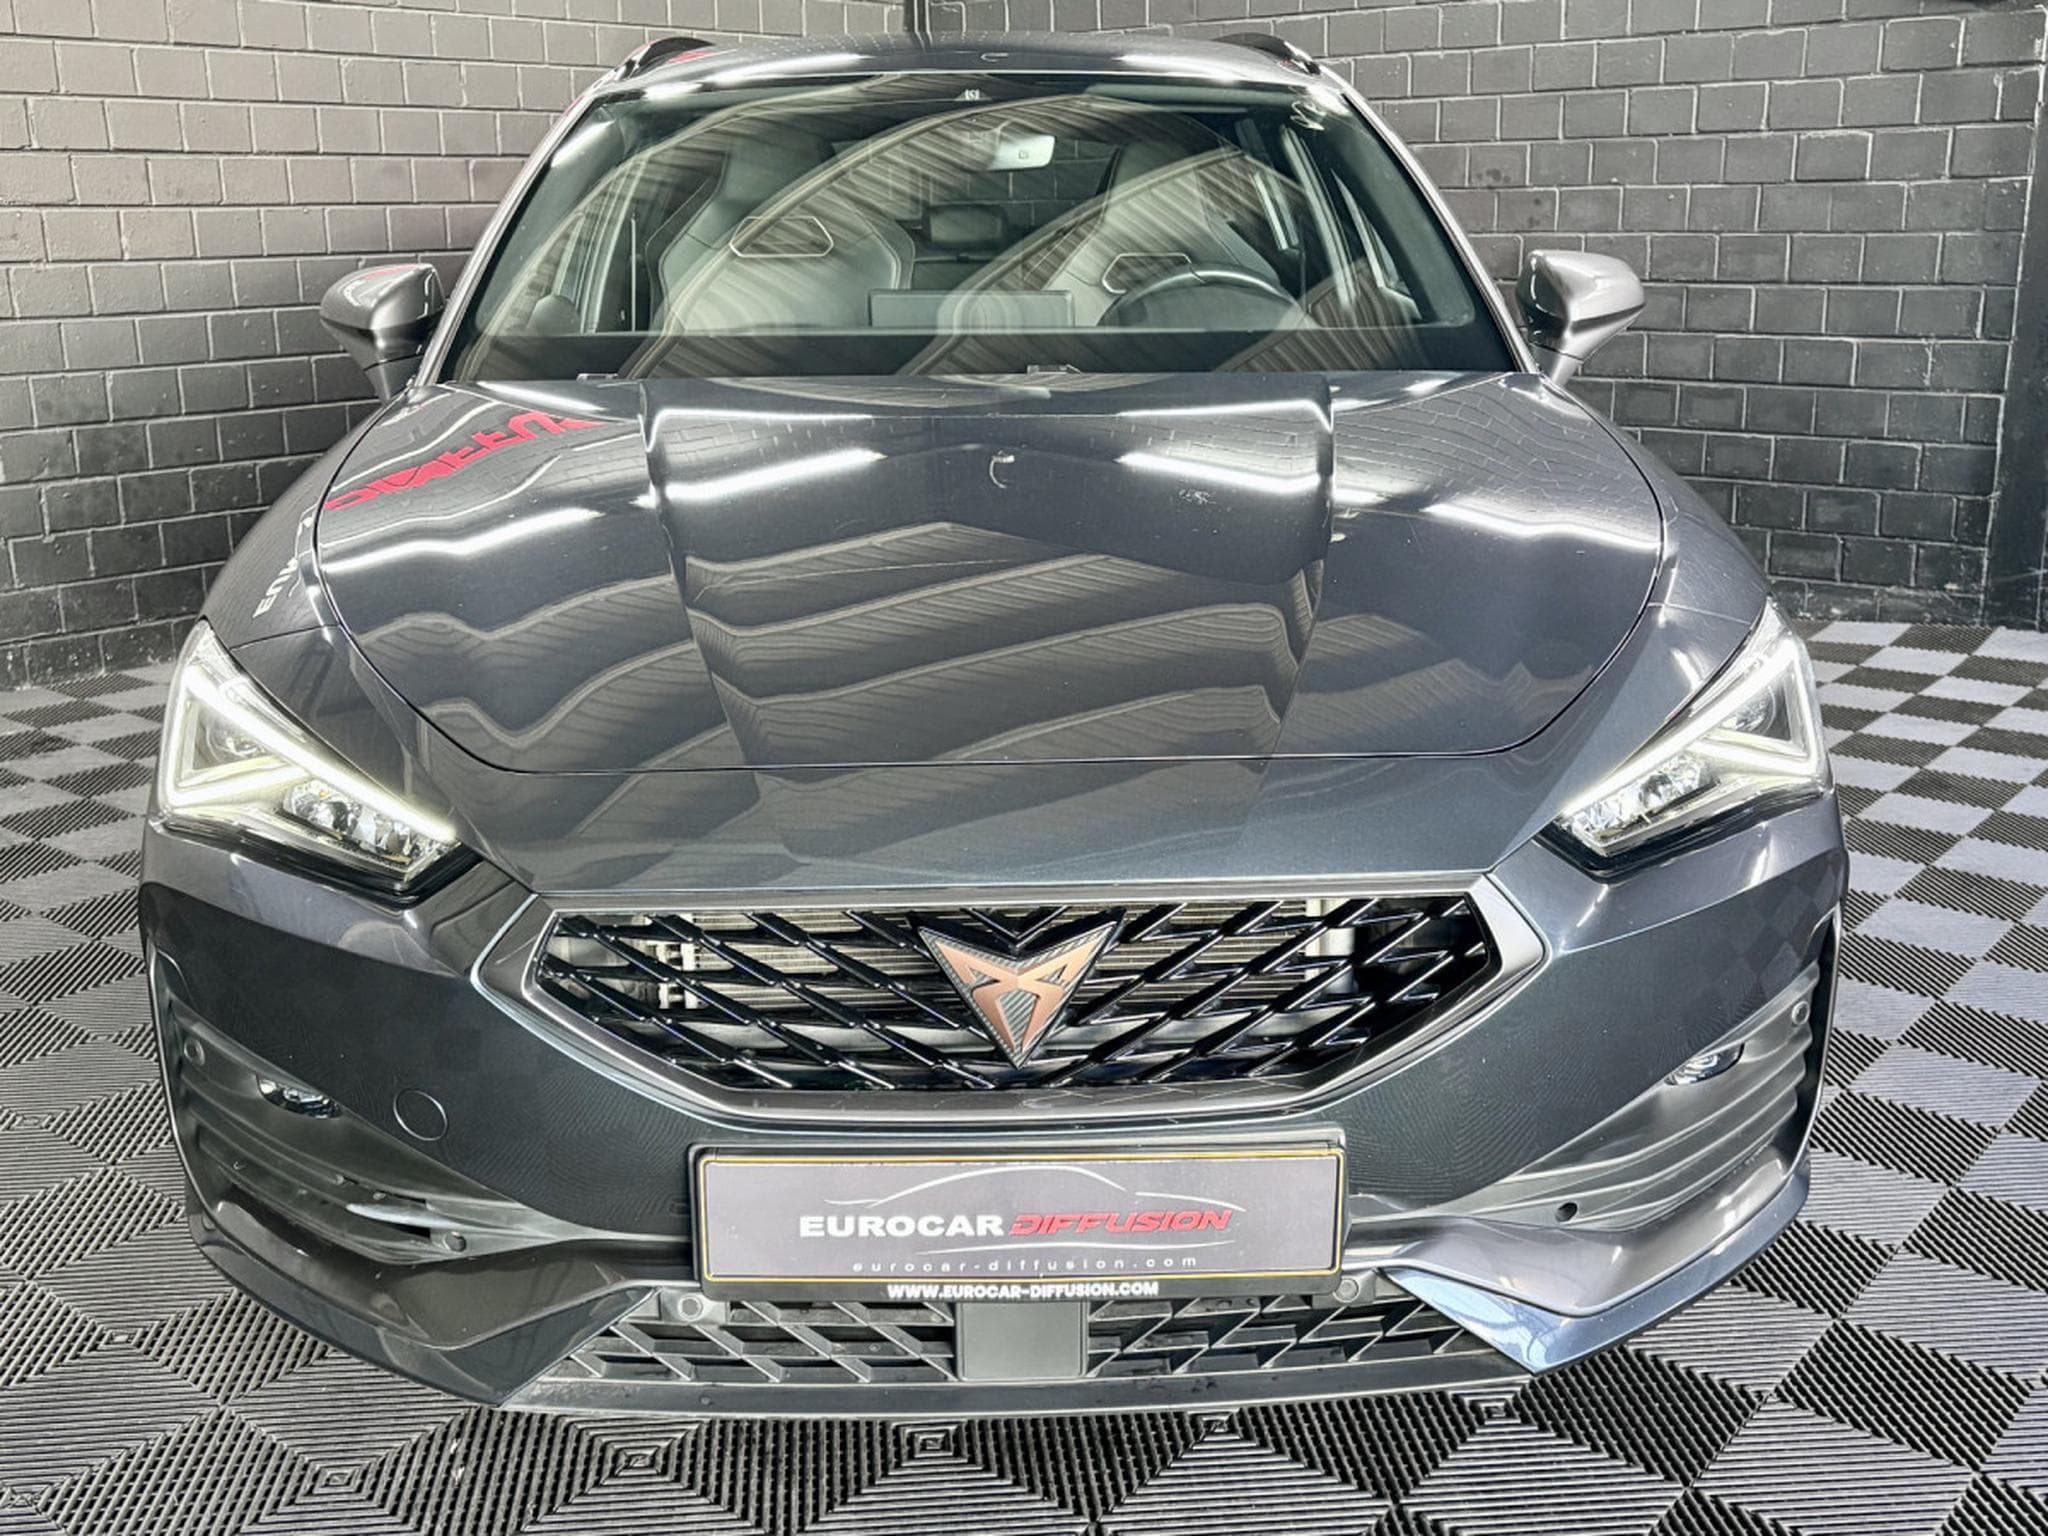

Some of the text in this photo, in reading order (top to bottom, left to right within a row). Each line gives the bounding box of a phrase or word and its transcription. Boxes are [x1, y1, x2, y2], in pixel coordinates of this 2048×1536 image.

[800, 1209, 1232, 1238] EUROCAR DIFFUSION
[853, 1257, 1196, 1273] eurocar-diffusion.com
[887, 1281, 1159, 1299] WWW.EUROCAR-DIFFUSION.COM
